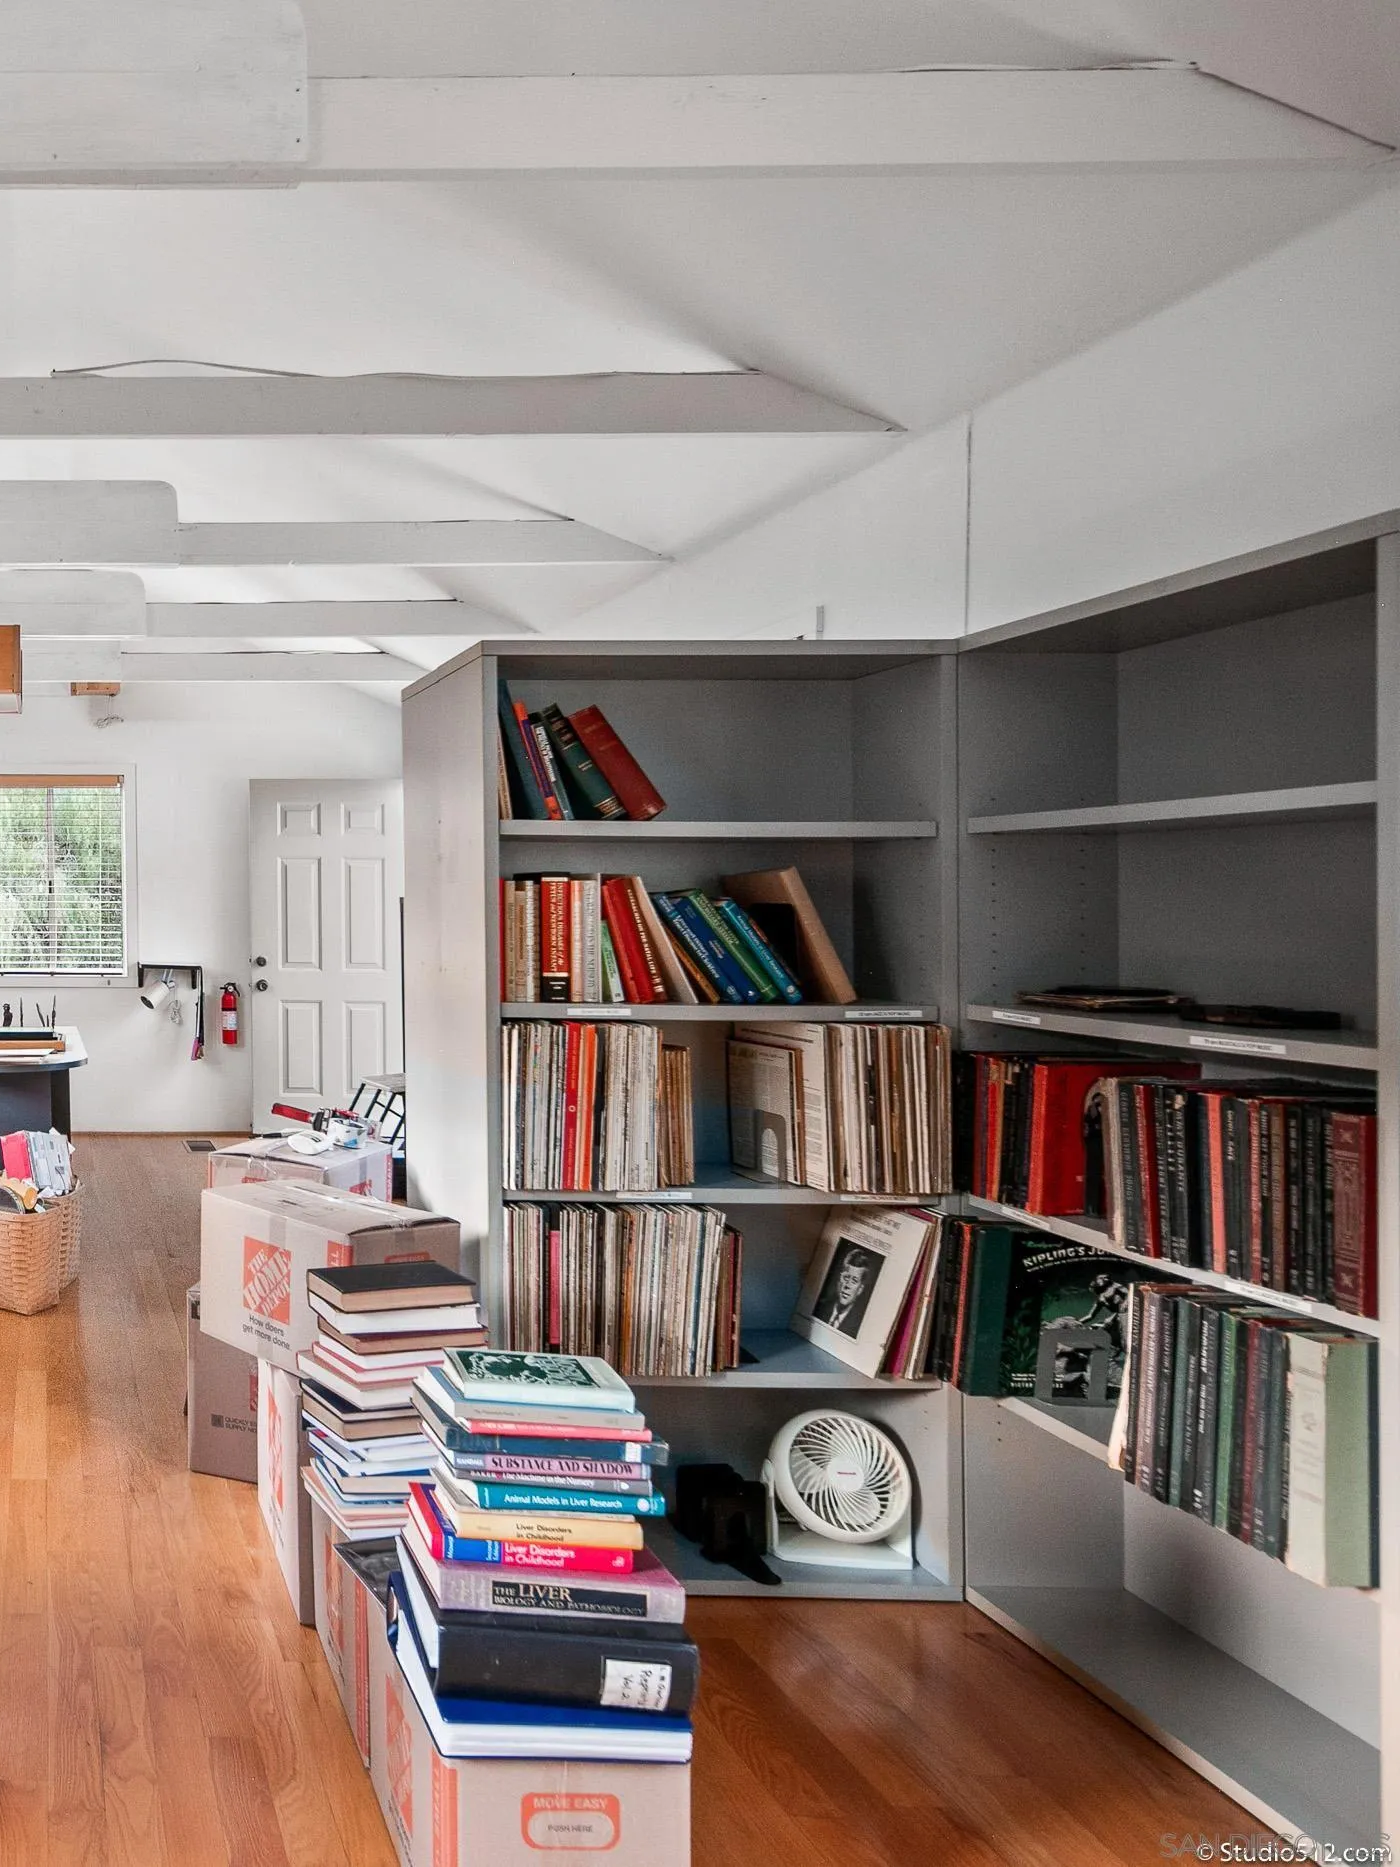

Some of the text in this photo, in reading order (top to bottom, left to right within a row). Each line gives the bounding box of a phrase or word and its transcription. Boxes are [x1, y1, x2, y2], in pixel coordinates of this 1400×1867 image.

[1125, 1174, 1133, 1200] SONGS
[248, 1249, 268, 1275] THE
[1022, 1246, 1086, 1267] KIPLING'S
[243, 1249, 290, 1311] HOME
[261, 1279, 289, 1317] DEPOT
[243, 1323, 254, 1334] get
[254, 1329, 271, 1341] more
[249, 1315, 285, 1337] How doers
[491, 1457, 552, 1472] SUBSTANCE
[557, 1459, 580, 1473] AND
[582, 1461, 634, 1475] SHADOW
[502, 1472, 515, 1480] The
[516, 1472, 546, 1483] Machine
[555, 1476, 567, 1484] the
[567, 1477, 595, 1488] Nursery
[503, 1494, 623, 1509] Animal Models in Liver Research
[516, 1523, 572, 1534] Liver Disorders
[525, 1533, 565, 1542] Childhood
[504, 1543, 575, 1558] Liver Disorders
[504, 1554, 565, 1568] in Childhood
[495, 1583, 572, 1602] THE LIVER
[494, 1596, 643, 1615] BIOLOGY AND PATHOBIOLOGY
[533, 1796, 607, 1809] MOVE EASY
